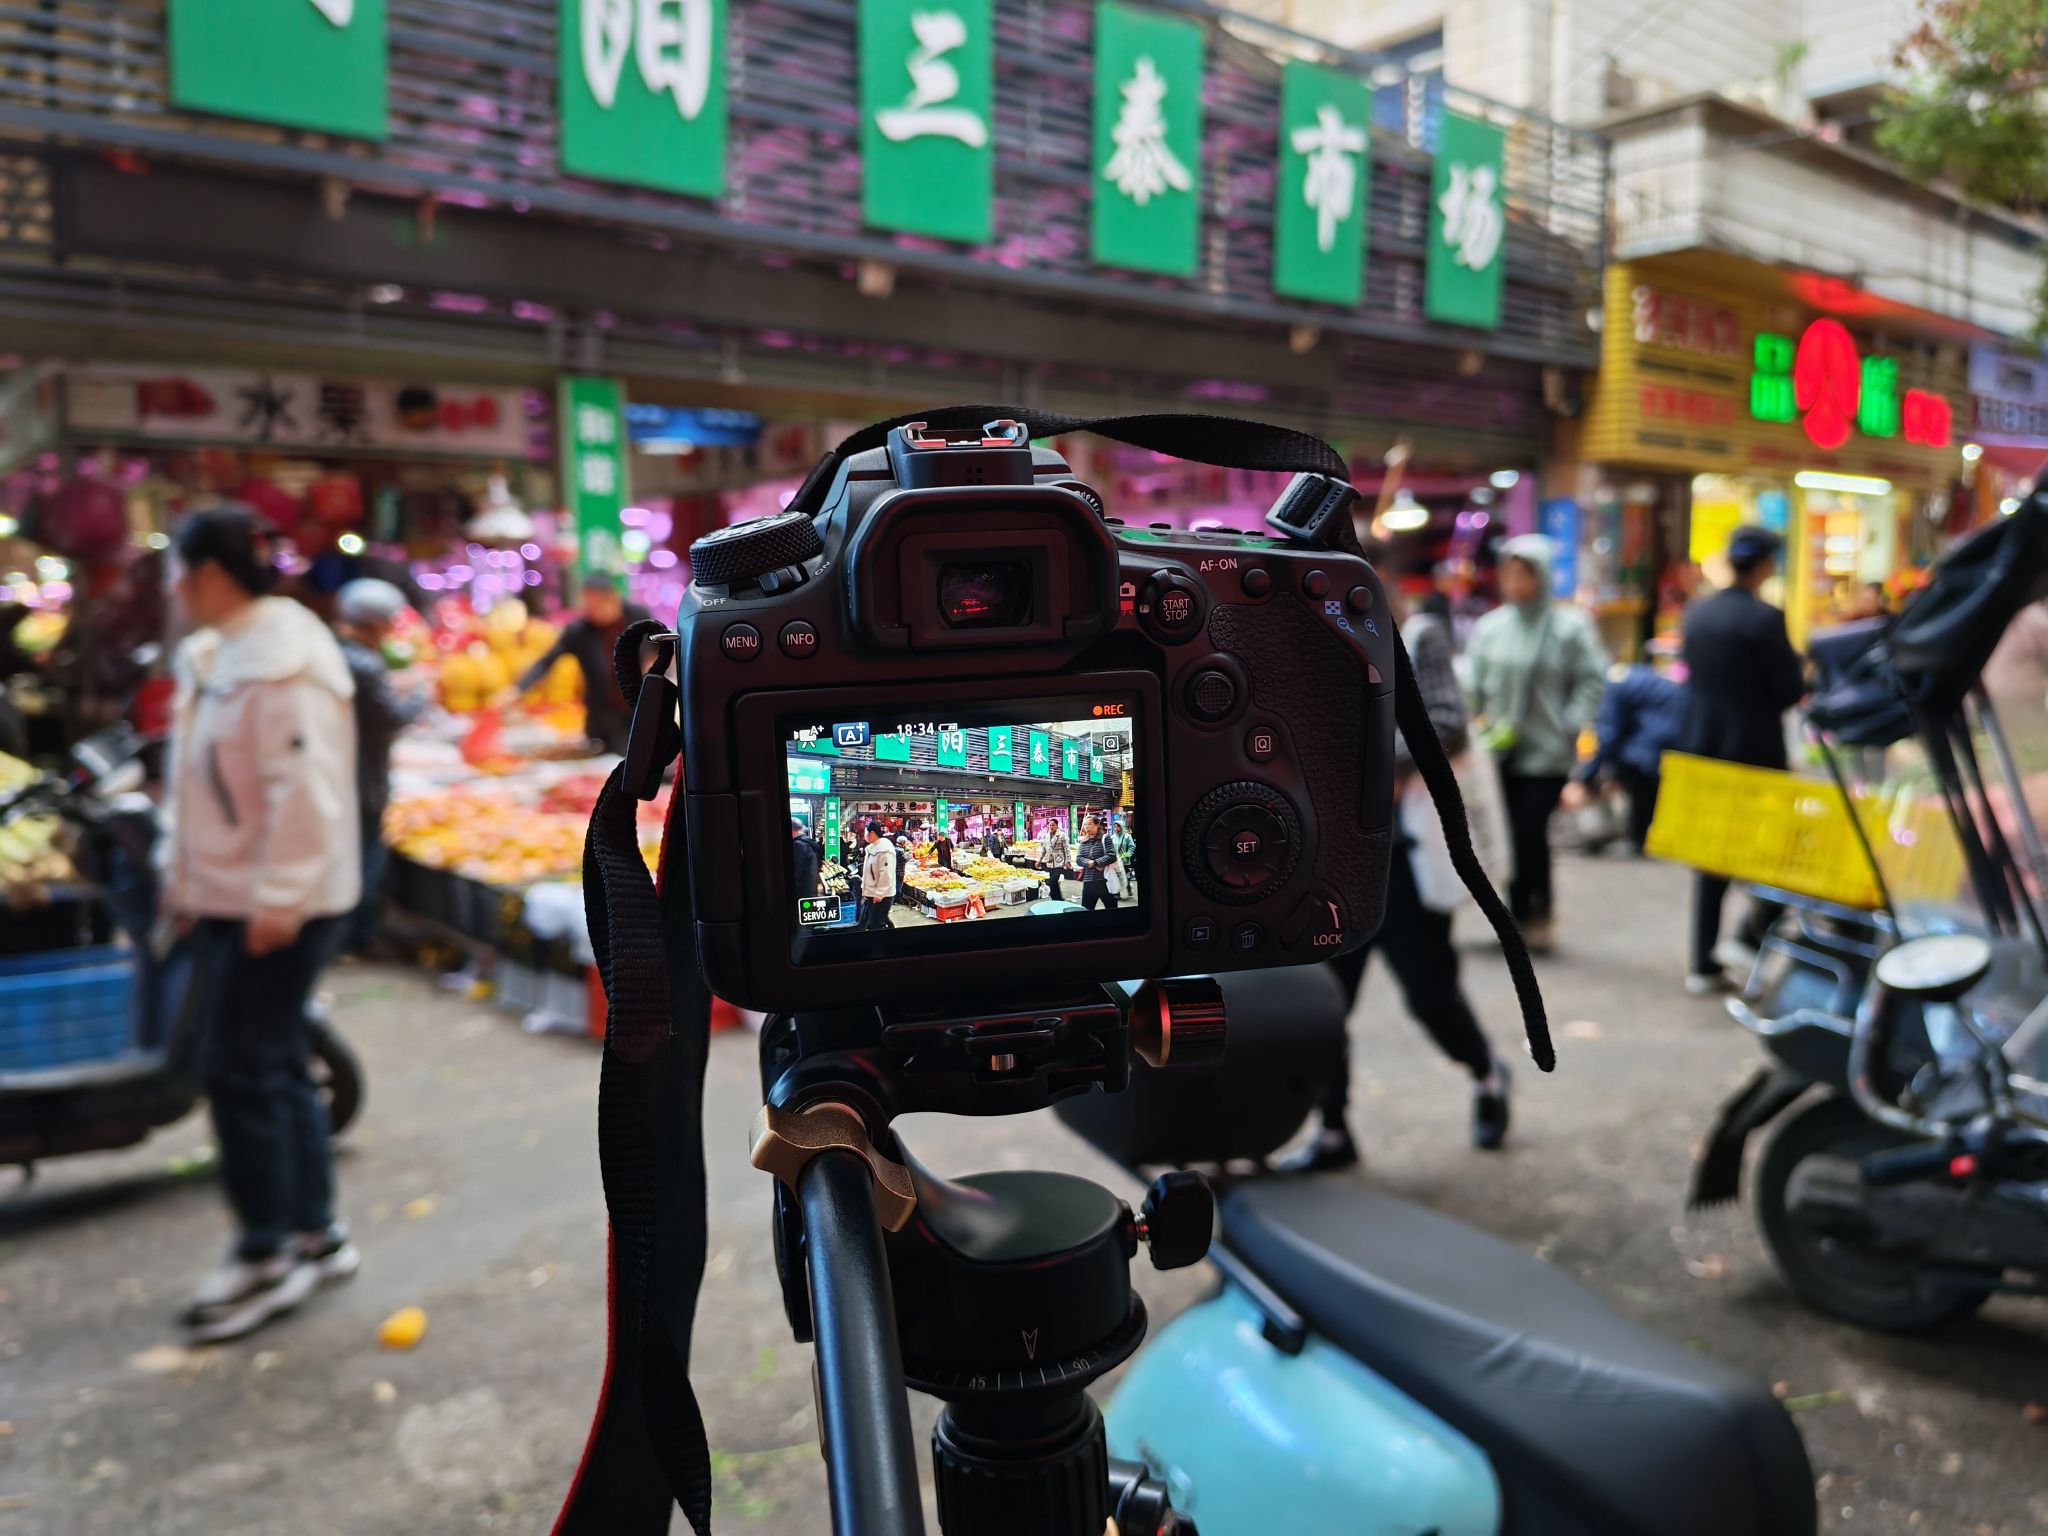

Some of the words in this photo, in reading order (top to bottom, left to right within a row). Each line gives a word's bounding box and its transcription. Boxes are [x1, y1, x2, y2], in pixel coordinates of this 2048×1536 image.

[310, 0, 1503, 272] 阳三泰市场
[1308, 487, 1343, 531] Canon
[814, 561, 831, 576] ON
[1200, 558, 1238, 572] AF-ON
[702, 597, 727, 607] OFF
[1162, 598, 1190, 611] START
[1165, 609, 1188, 622] STOP
[725, 635, 758, 649] MENU
[786, 632, 815, 646] INFO
[1103, 704, 1124, 716] REC
[897, 722, 935, 737] 18:34
[1258, 738, 1268, 750] Q
[1236, 841, 1257, 854] SET
[803, 910, 827, 921] SERVO
[828, 909, 838, 919] AF
[1313, 934, 1343, 946] LOCK
[1072, 1358, 1091, 1373] 90
[968, 1376, 986, 1391] 45
